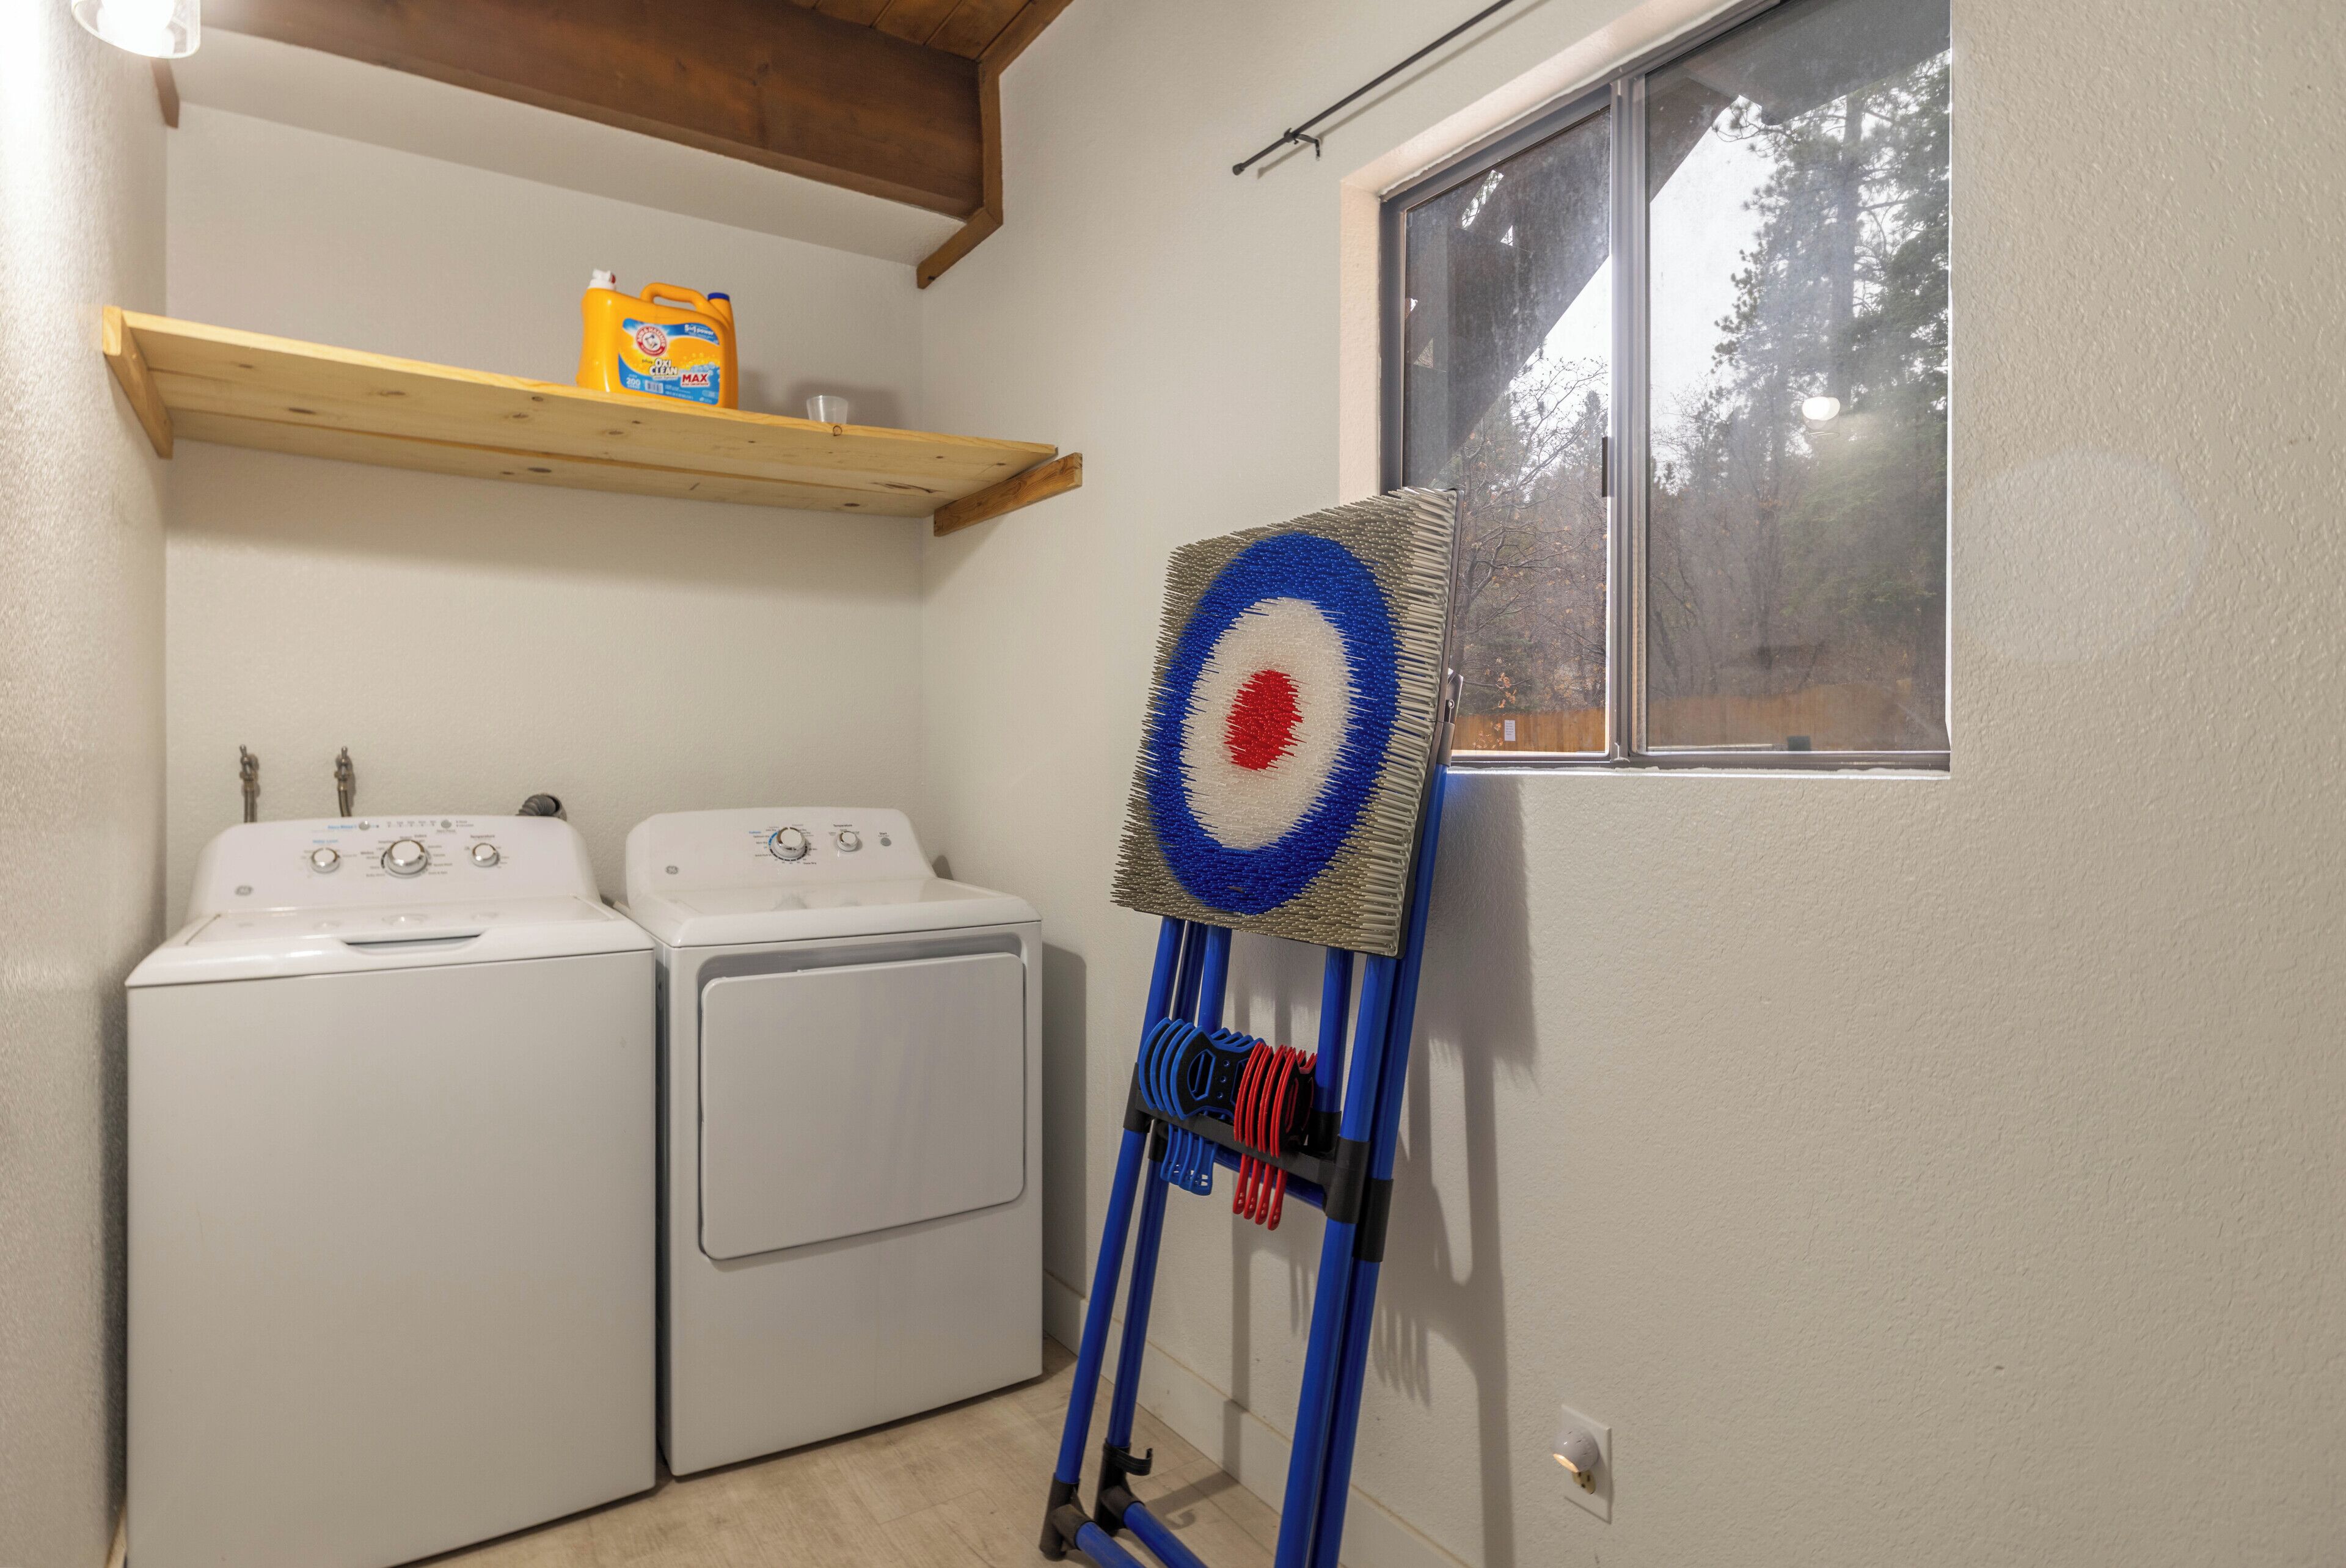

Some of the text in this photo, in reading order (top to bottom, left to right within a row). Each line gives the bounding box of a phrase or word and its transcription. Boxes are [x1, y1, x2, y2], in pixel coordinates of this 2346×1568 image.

[655, 358, 671, 368] OXI
[649, 365, 678, 376] CLEAN
[682, 373, 709, 382] MAX
